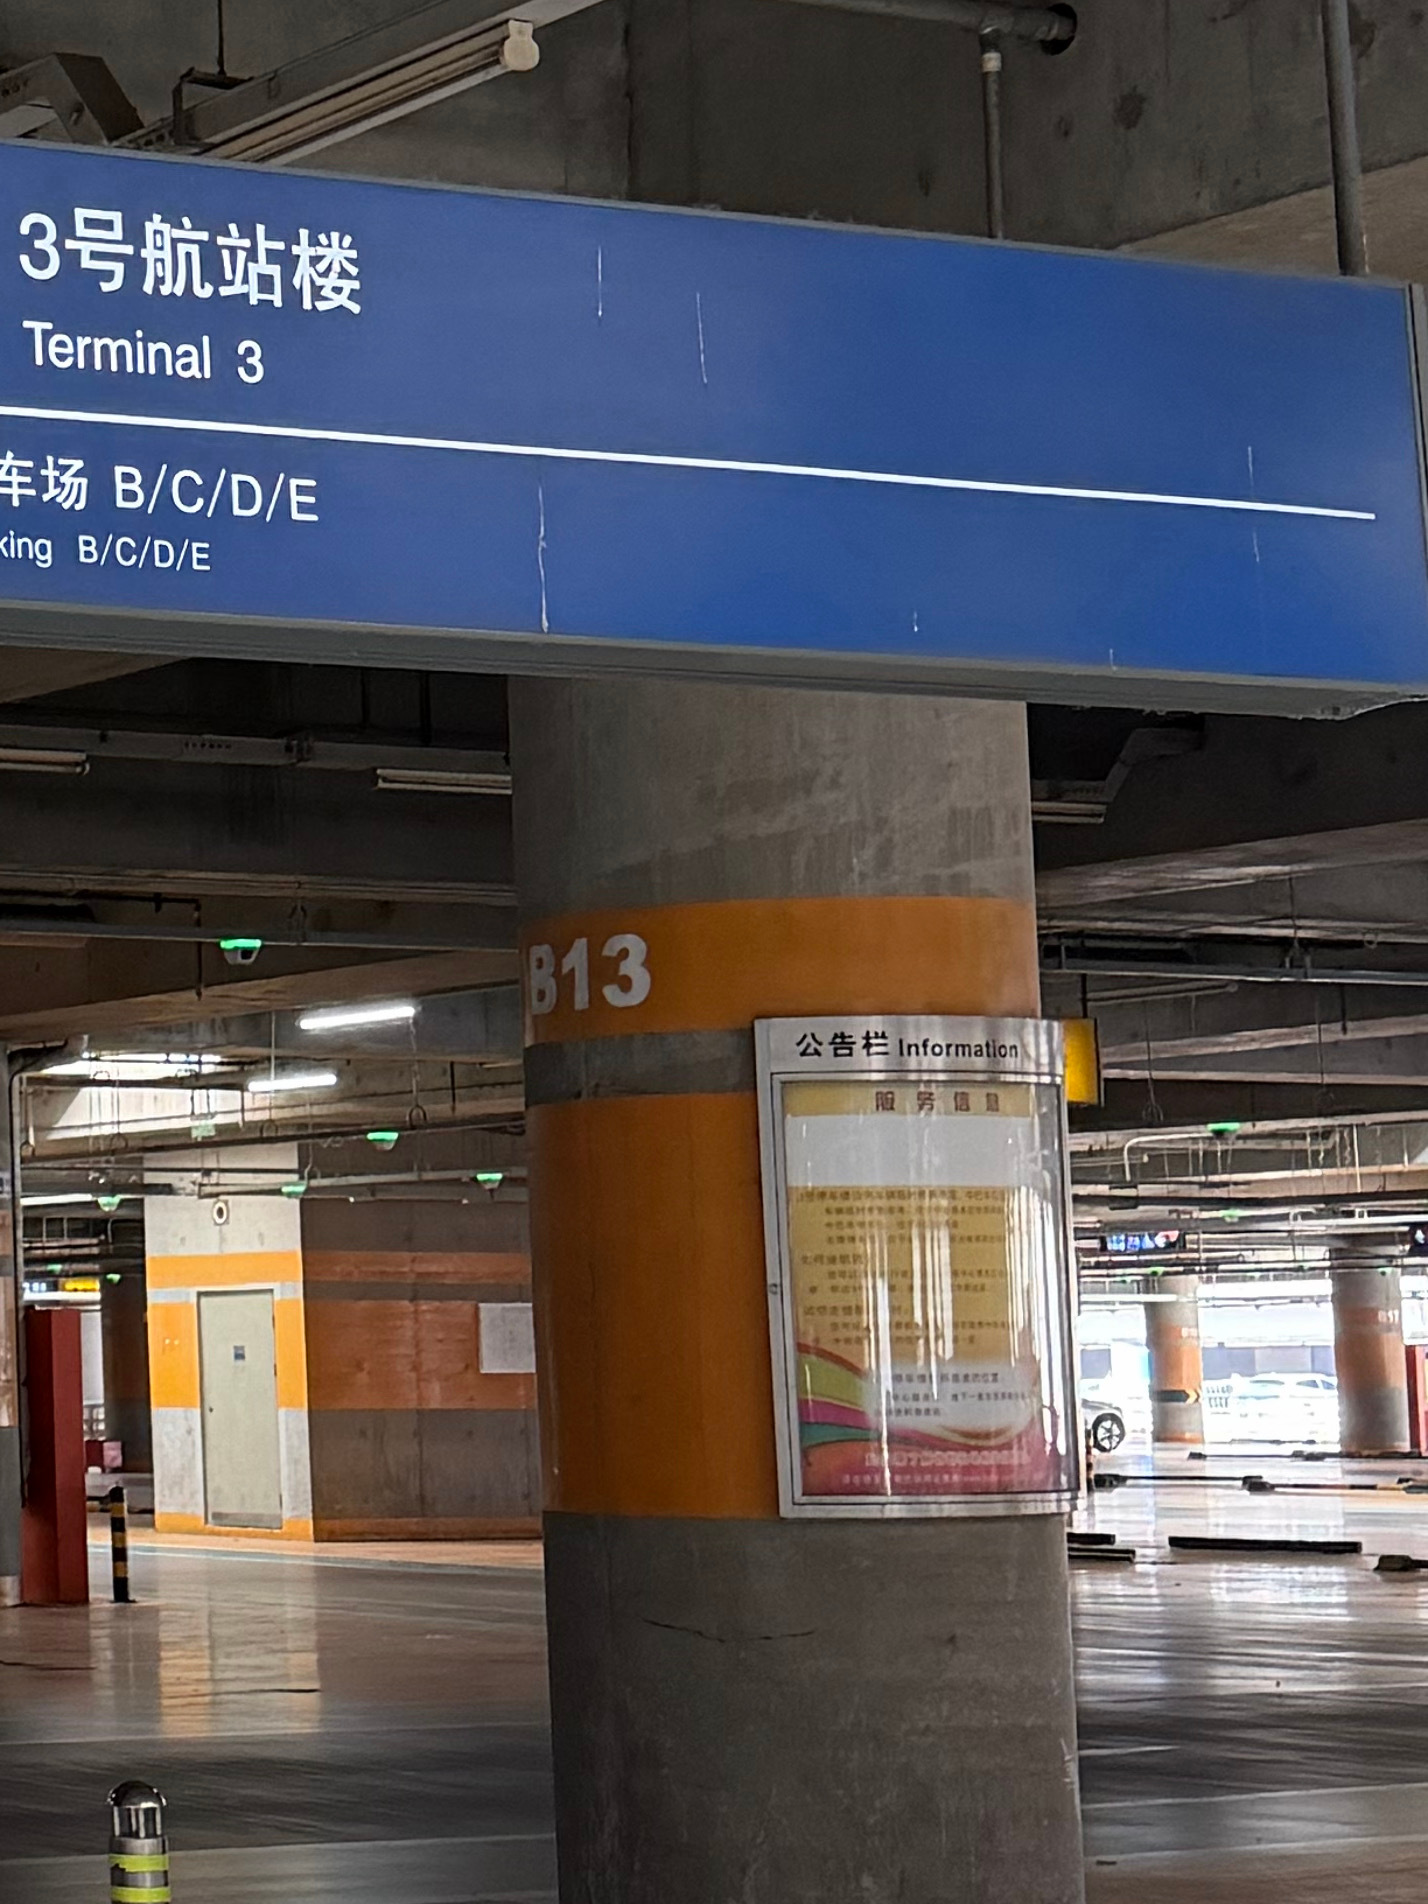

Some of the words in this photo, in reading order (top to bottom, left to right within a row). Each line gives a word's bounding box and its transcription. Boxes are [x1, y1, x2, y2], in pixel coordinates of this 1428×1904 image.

[18, 206, 363, 315] 3号航站楼
[22, 320, 211, 380] Terminal
[236, 339, 265, 384] 3
[113, 463, 320, 524] B/C/D/E
[77, 533, 211, 572] B/C/D/E
[529, 932, 651, 1016] B13
[795, 1030, 890, 1059] 公告栏
[898, 1037, 1019, 1060] Information
